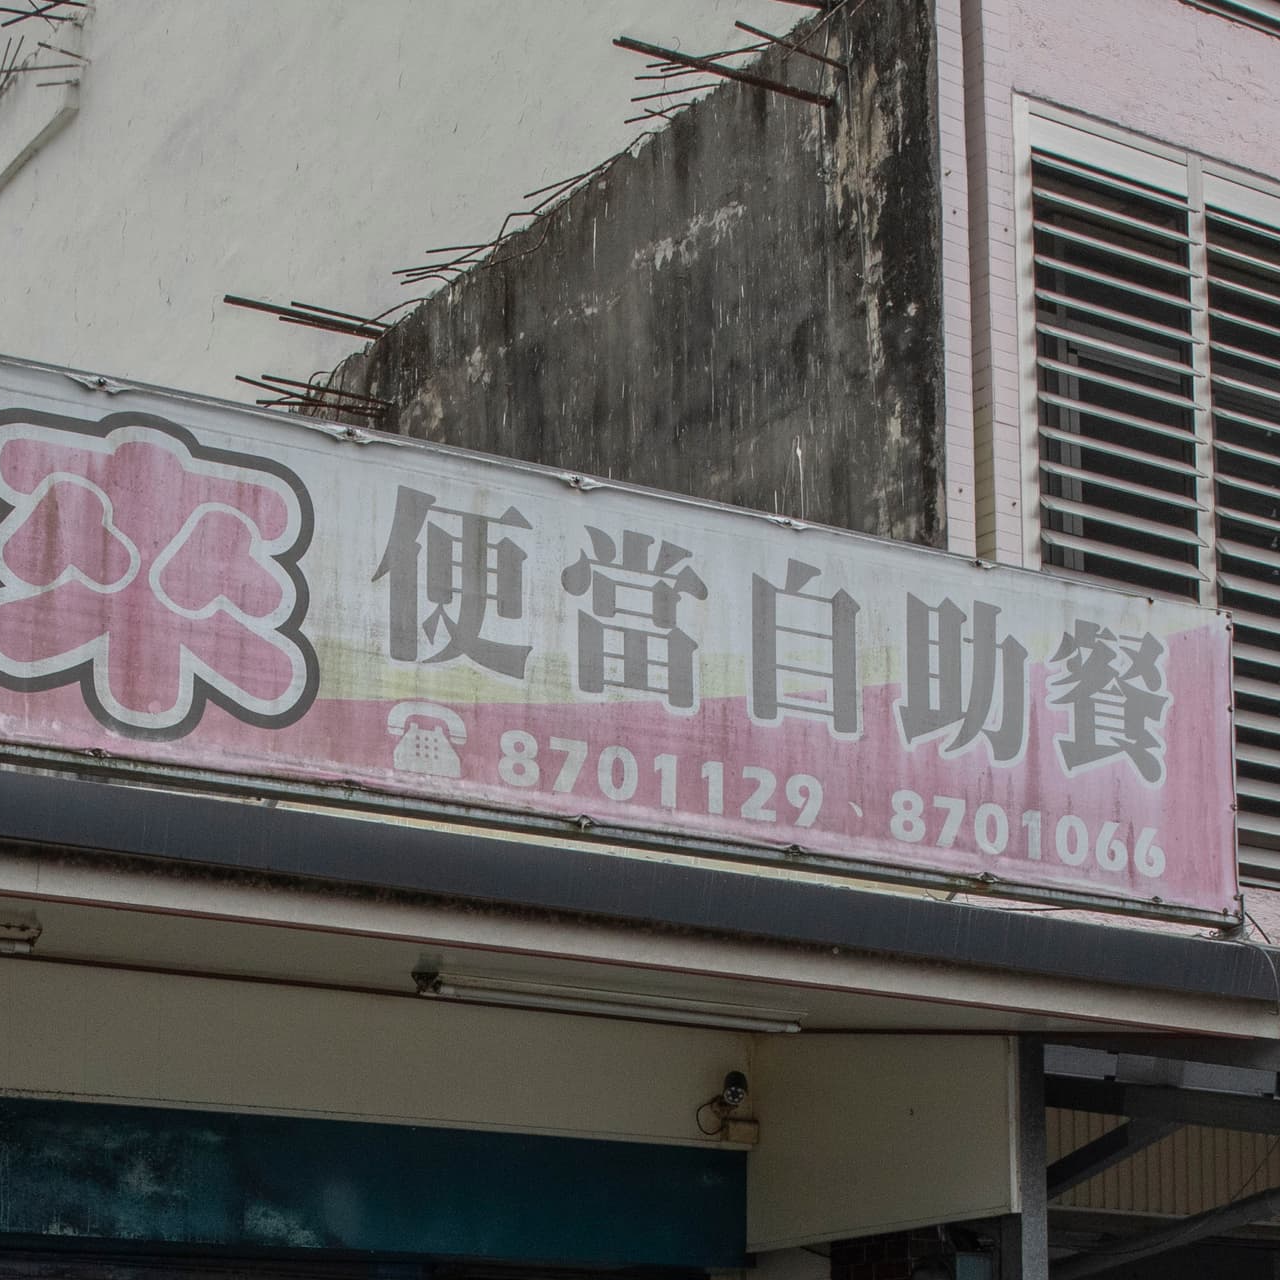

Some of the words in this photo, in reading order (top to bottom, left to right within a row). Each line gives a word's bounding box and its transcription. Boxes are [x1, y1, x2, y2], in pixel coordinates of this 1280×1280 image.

[372, 484, 1169, 785] 便當自助餐
[889, 788, 1167, 878] 8701066
